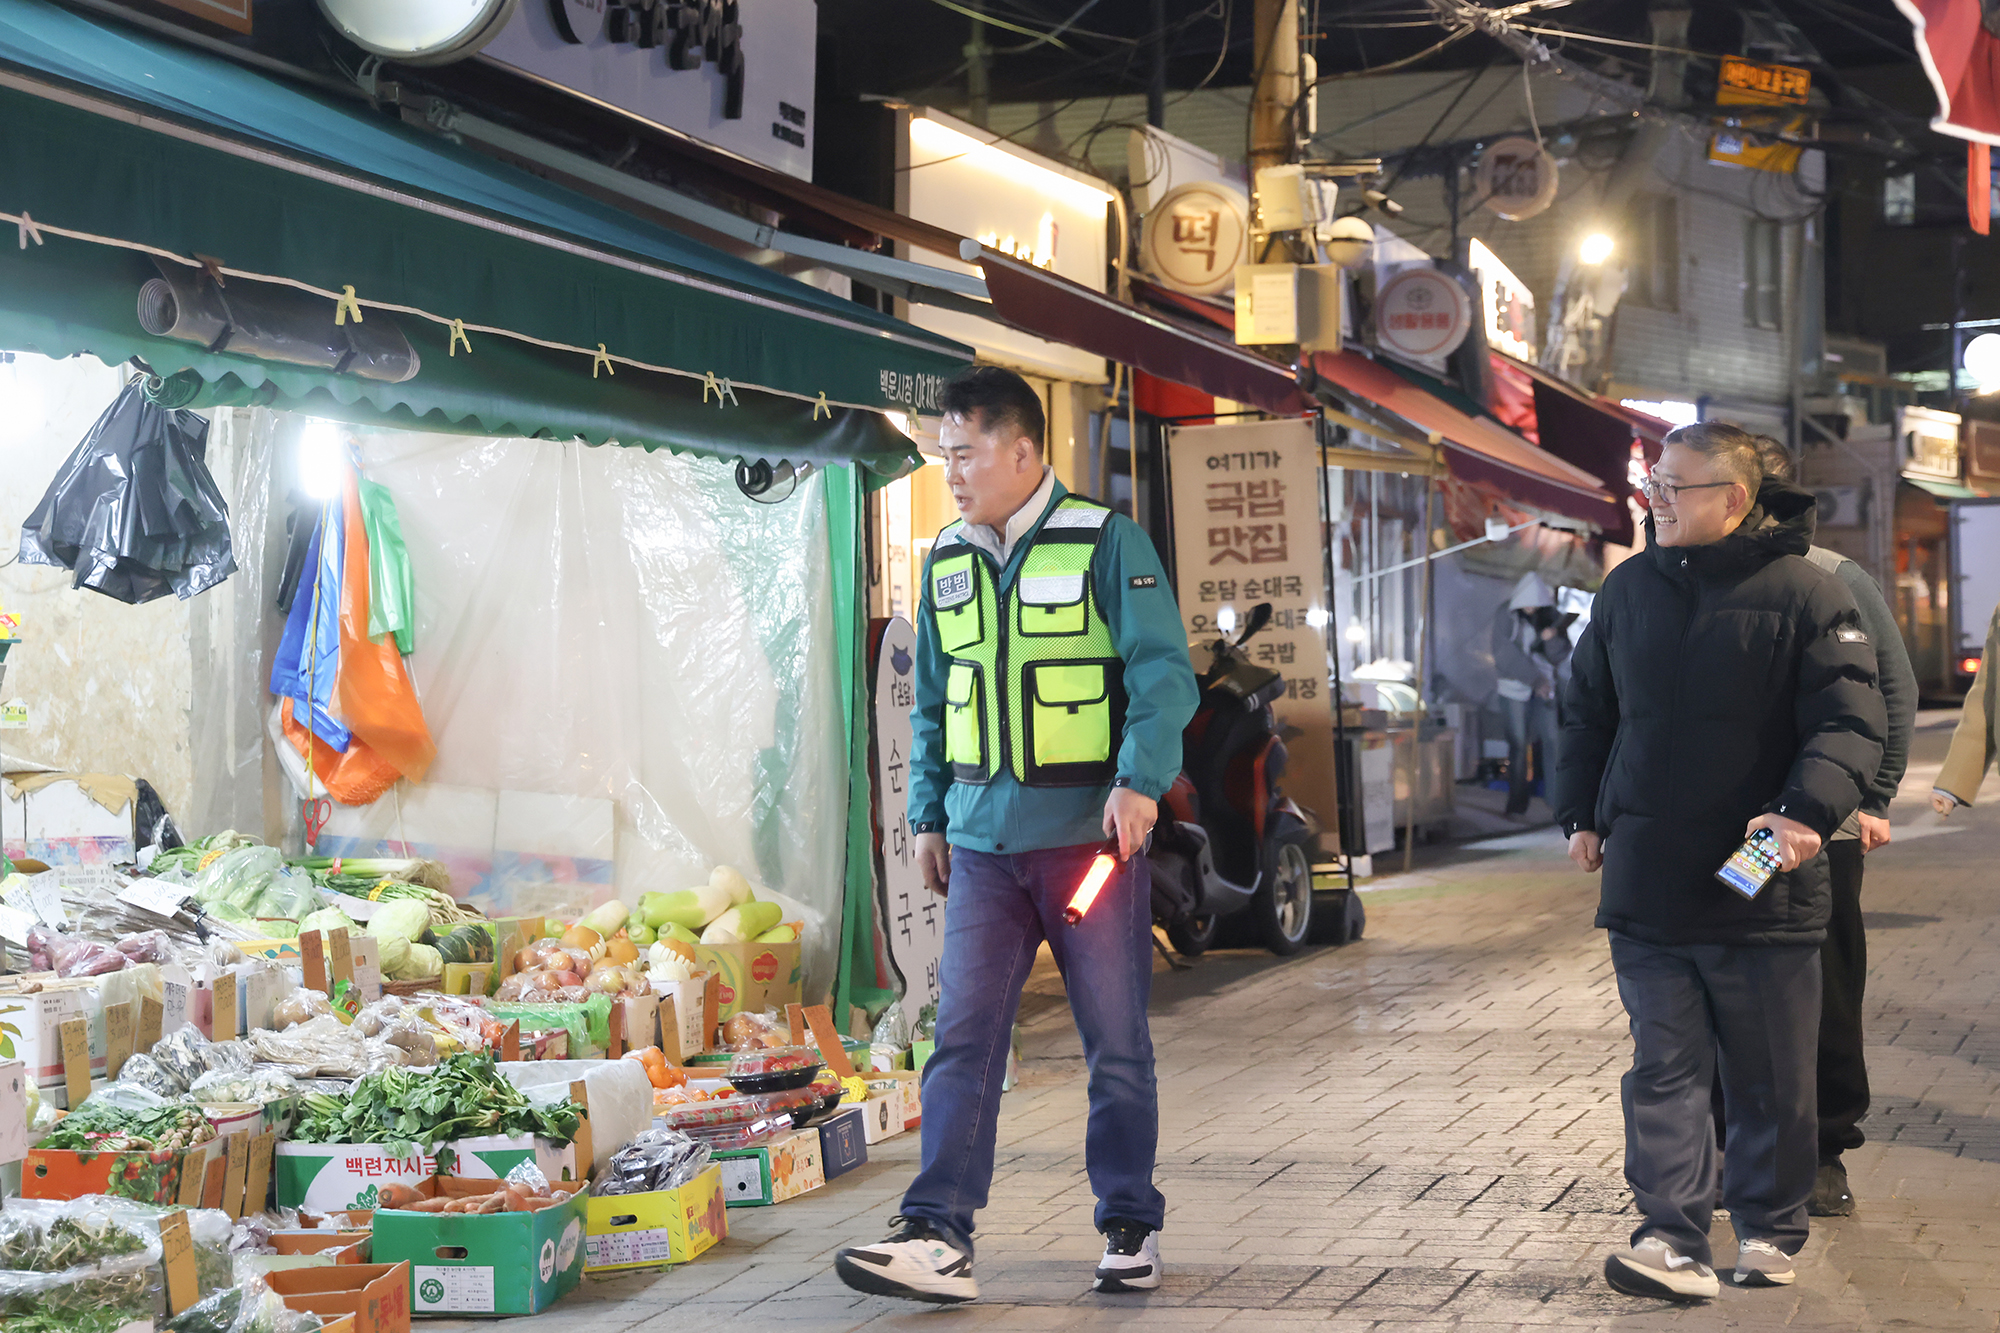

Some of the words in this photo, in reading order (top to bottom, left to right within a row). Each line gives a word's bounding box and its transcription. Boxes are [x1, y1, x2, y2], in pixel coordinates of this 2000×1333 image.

[1171, 209, 1219, 272] 떡
[880, 369, 913, 404] 백운시장
[1206, 450, 1282, 471] 여기가
[1205, 478, 1287, 519] 국밥
[1207, 523, 1288, 566] 맛집
[940, 572, 966, 595] 방범
[1198, 579, 1237, 602] 온담
[1243, 575, 1303, 600] 순대국
[1257, 642, 1295, 664] 국밥
[888, 738, 912, 947] 순대국
[919, 885, 940, 1008] 국밥
